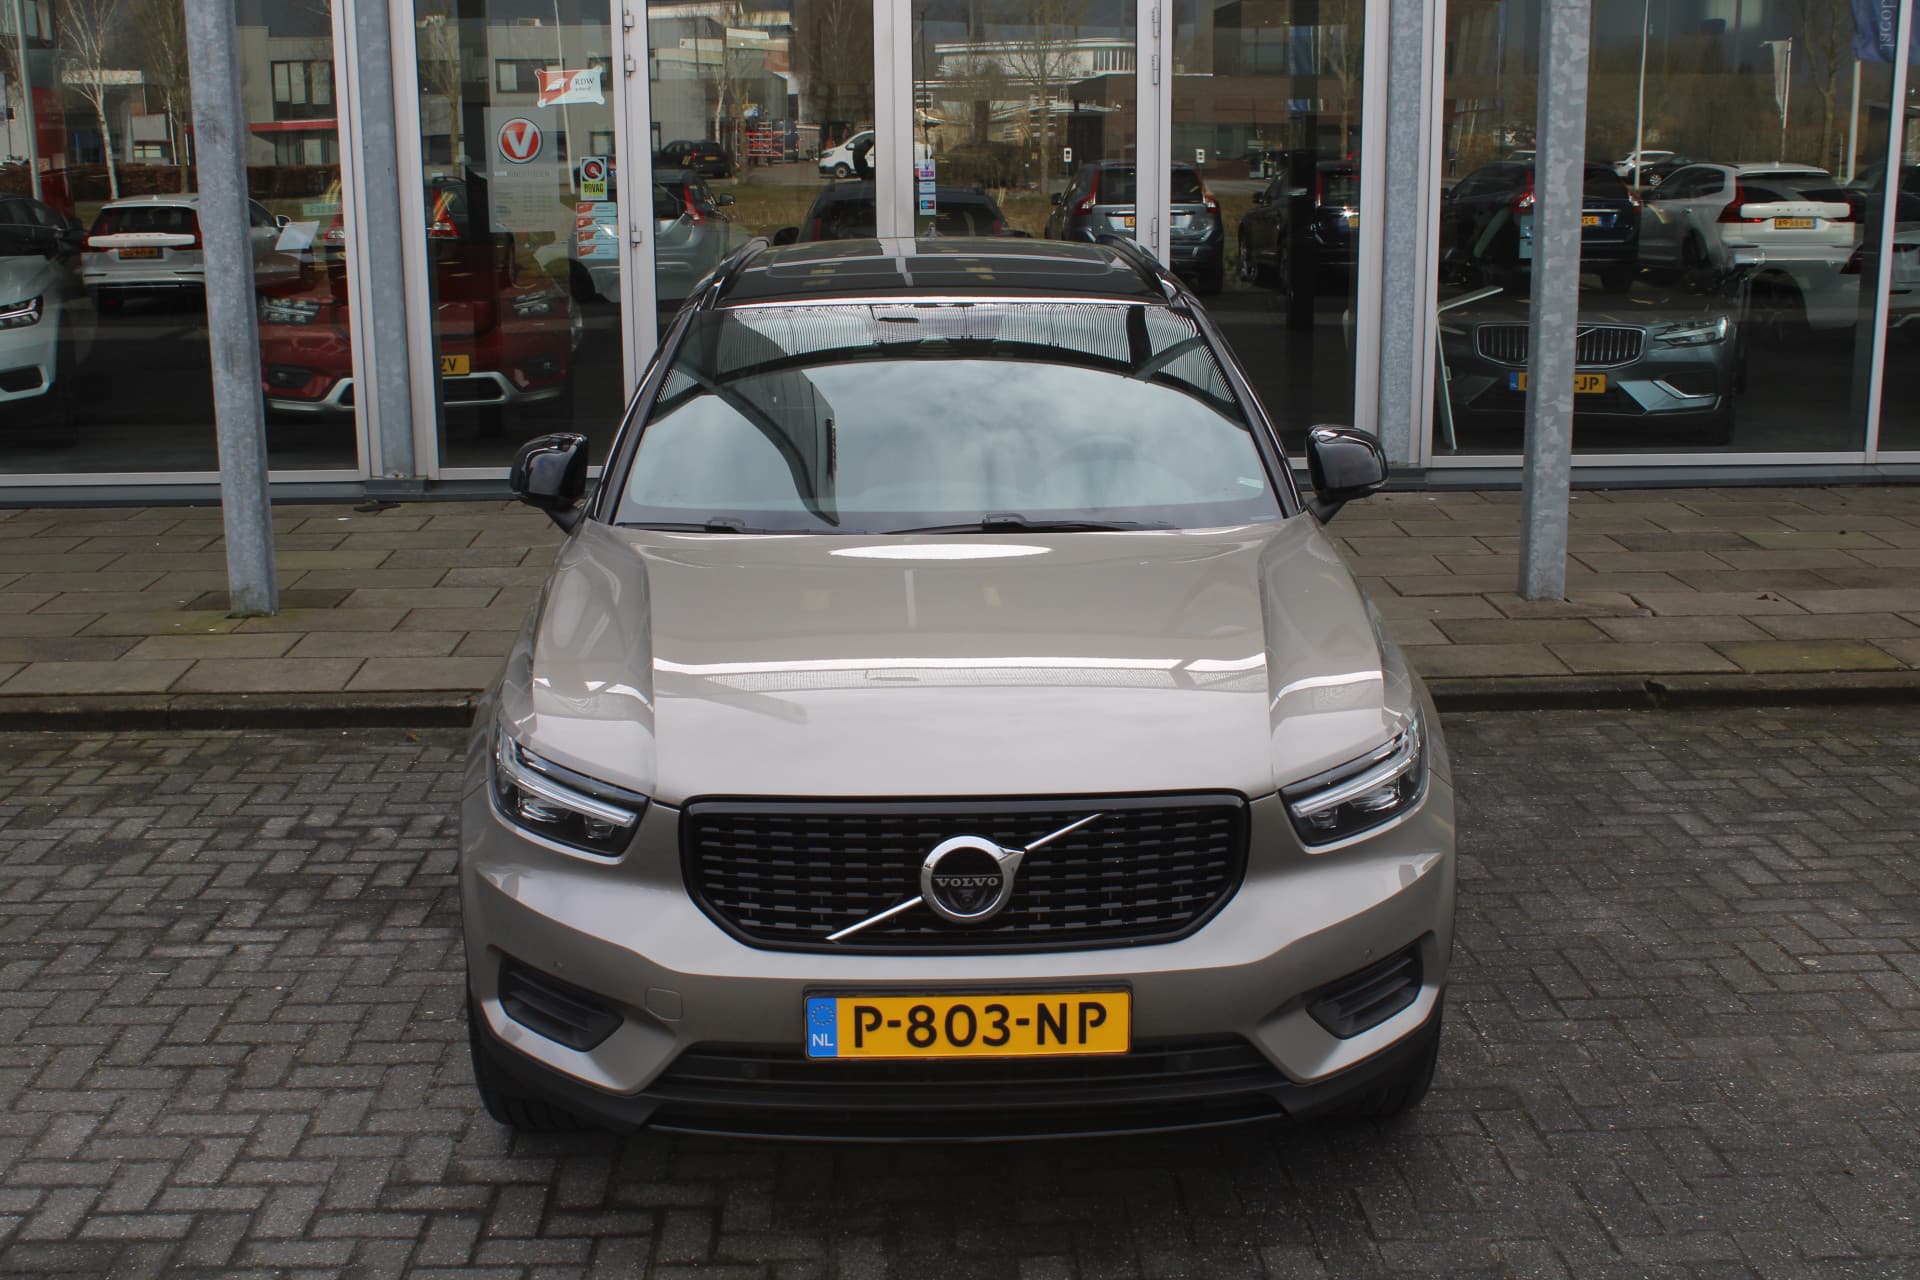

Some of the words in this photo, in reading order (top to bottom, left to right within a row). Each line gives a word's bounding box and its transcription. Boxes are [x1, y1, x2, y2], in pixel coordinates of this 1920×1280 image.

[935, 877, 999, 888] VOLVO
[854, 1001, 1107, 1049] P-803-NP
[812, 1033, 834, 1047] NL
